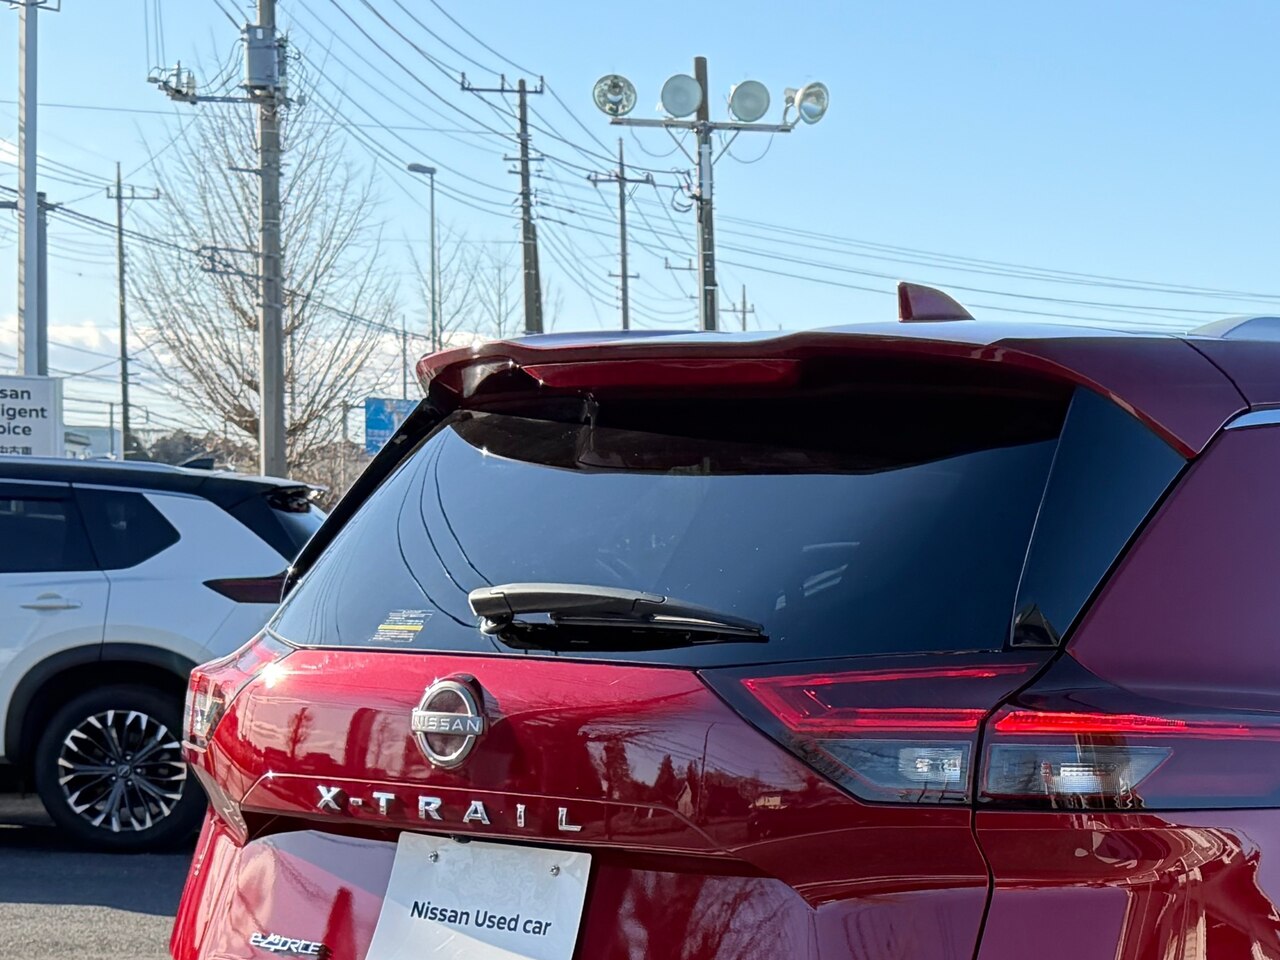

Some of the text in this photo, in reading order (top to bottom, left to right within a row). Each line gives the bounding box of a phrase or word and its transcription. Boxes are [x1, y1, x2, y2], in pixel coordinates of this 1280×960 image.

[413, 714, 482, 733] NISSAN
[317, 785, 583, 832] X-TRAIL
[410, 900, 552, 936] Nissan Used car
